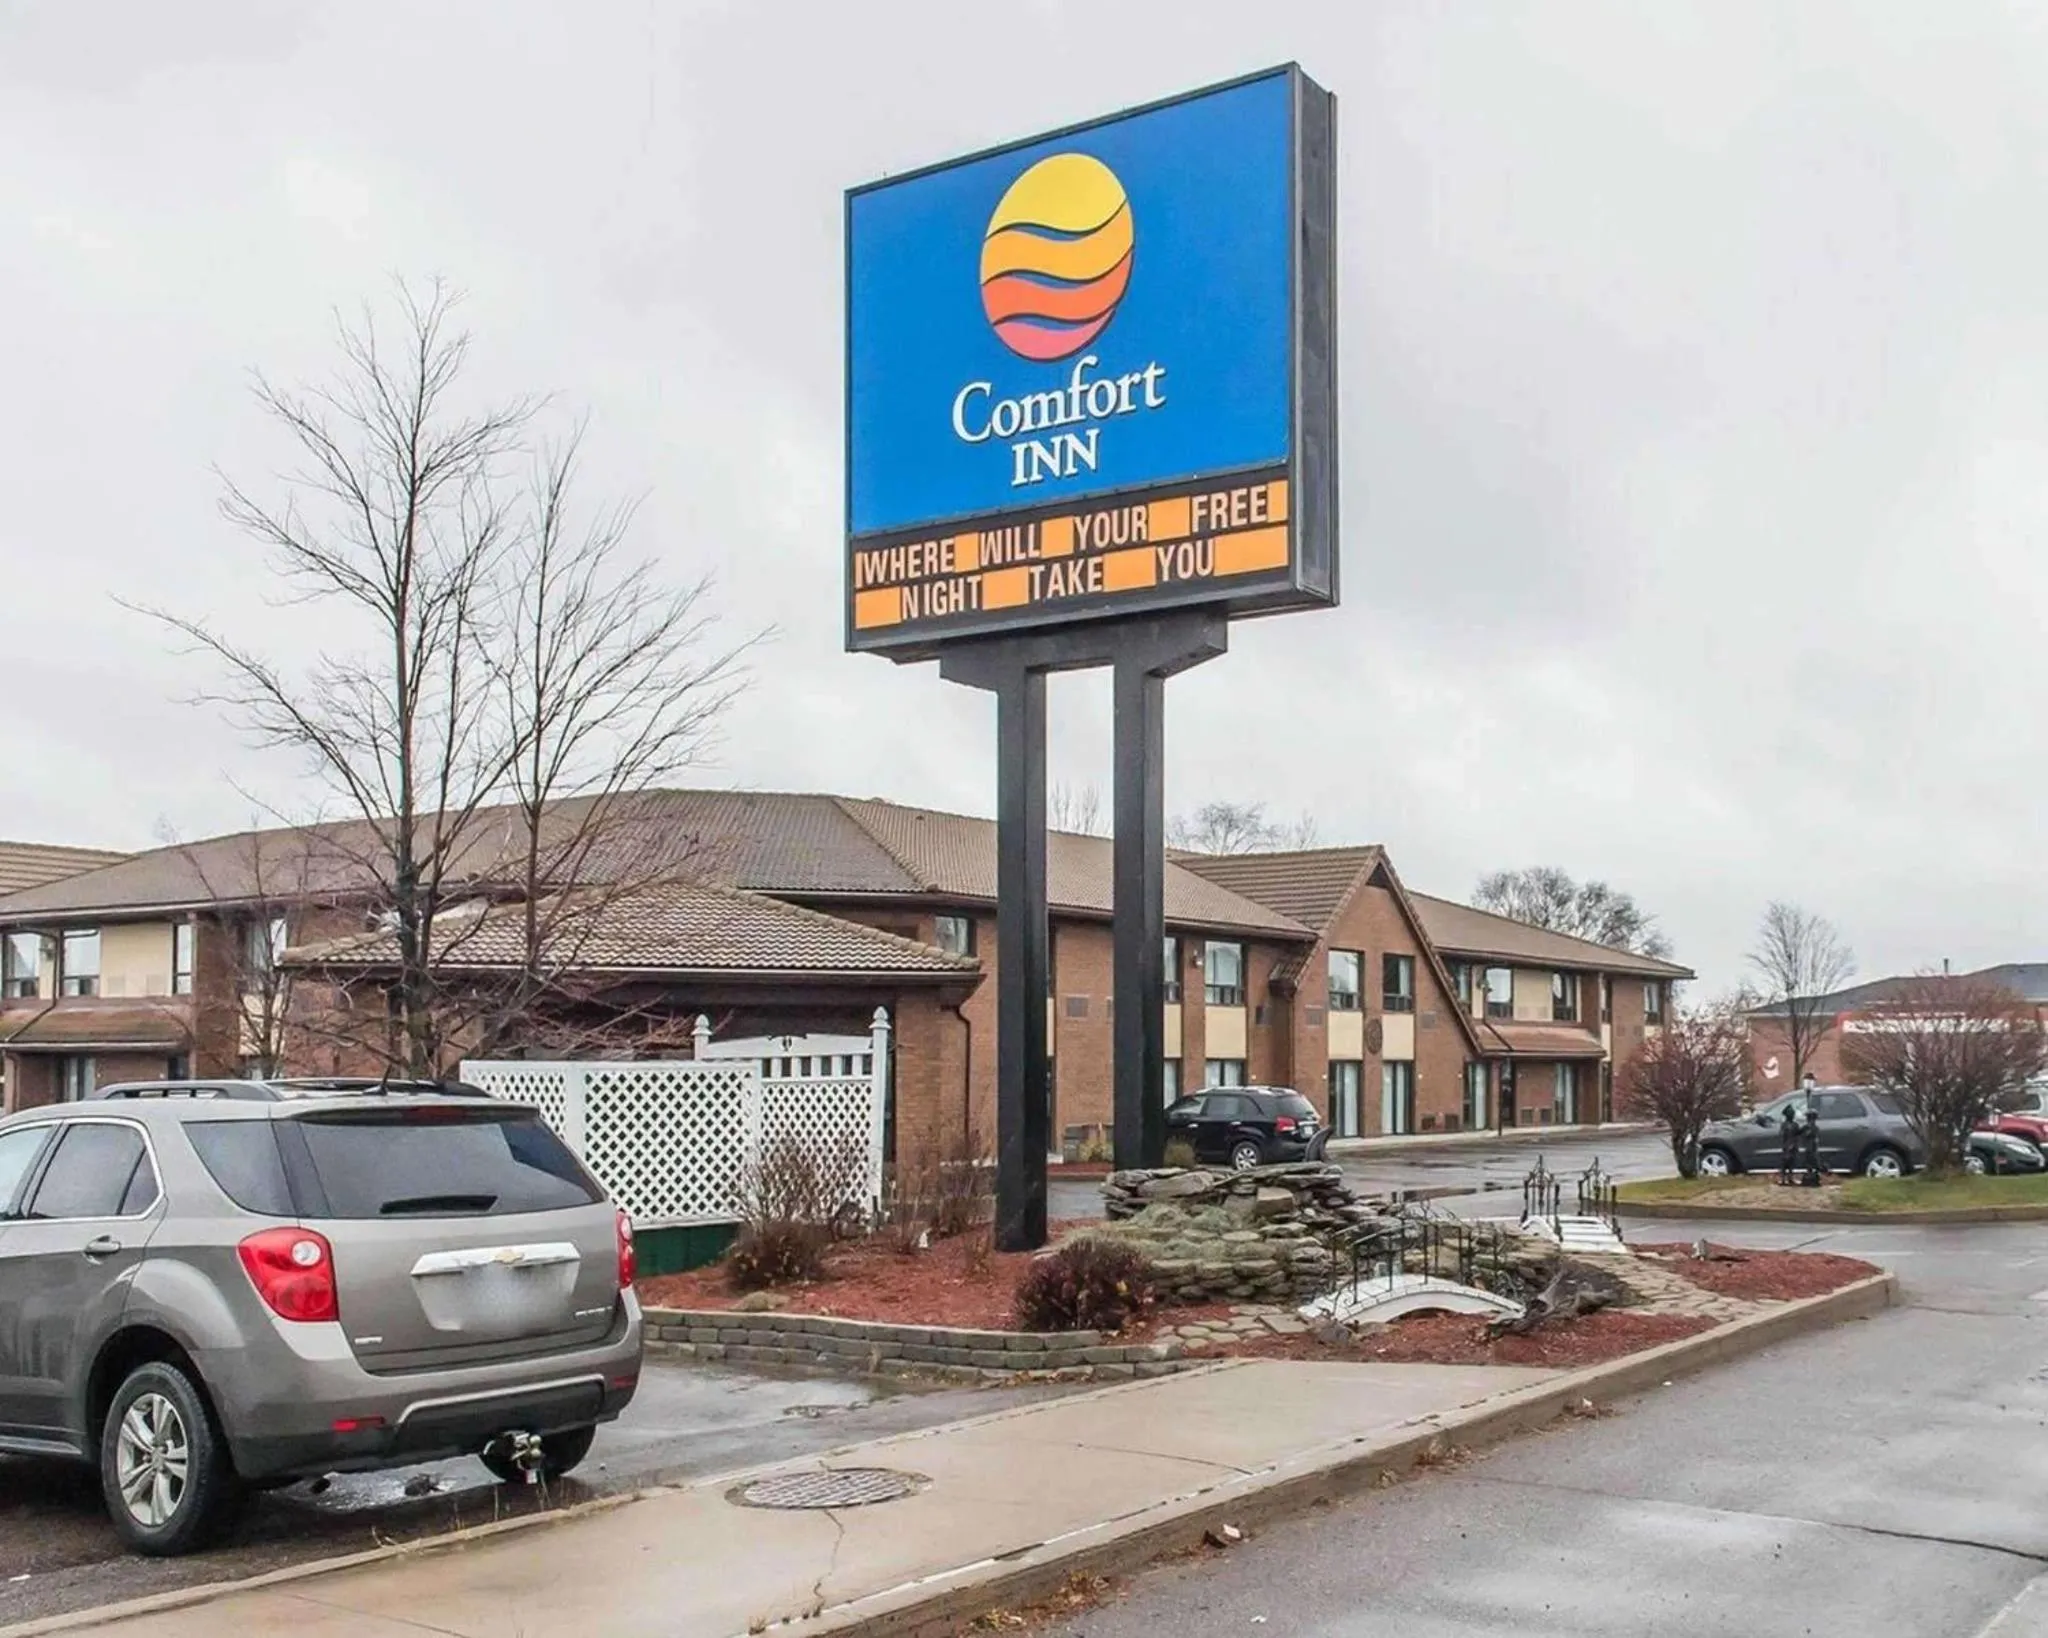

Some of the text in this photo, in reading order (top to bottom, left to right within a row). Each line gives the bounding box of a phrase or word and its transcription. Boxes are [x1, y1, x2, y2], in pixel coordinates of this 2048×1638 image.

[952, 354, 1167, 442] Comfort
[1011, 428, 1100, 487] INN
[862, 485, 1268, 585] WHERE WILL YOUR FREE
[902, 539, 1215, 621] NIGHT TAKE YOU
